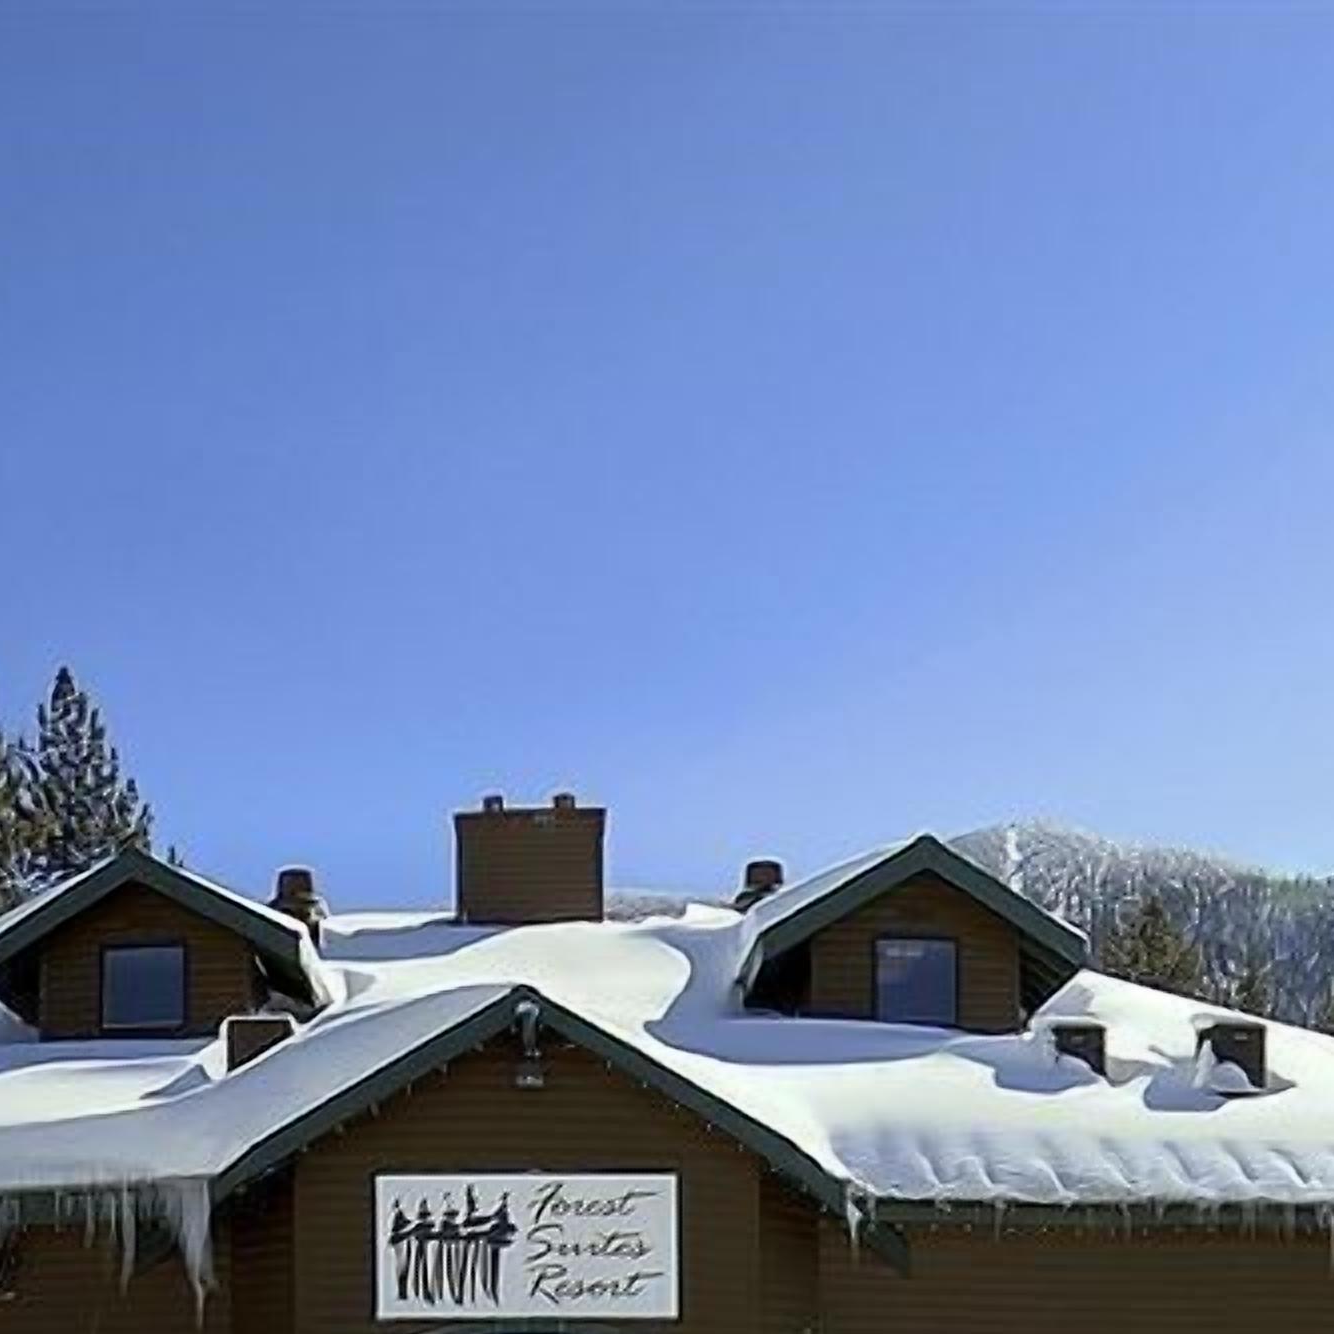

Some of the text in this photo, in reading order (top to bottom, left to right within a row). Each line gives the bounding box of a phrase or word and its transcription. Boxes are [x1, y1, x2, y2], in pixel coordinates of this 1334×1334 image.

[527, 1183, 661, 1223] Forest
[525, 1224, 652, 1261] Suites
[527, 1264, 664, 1304] Resort
